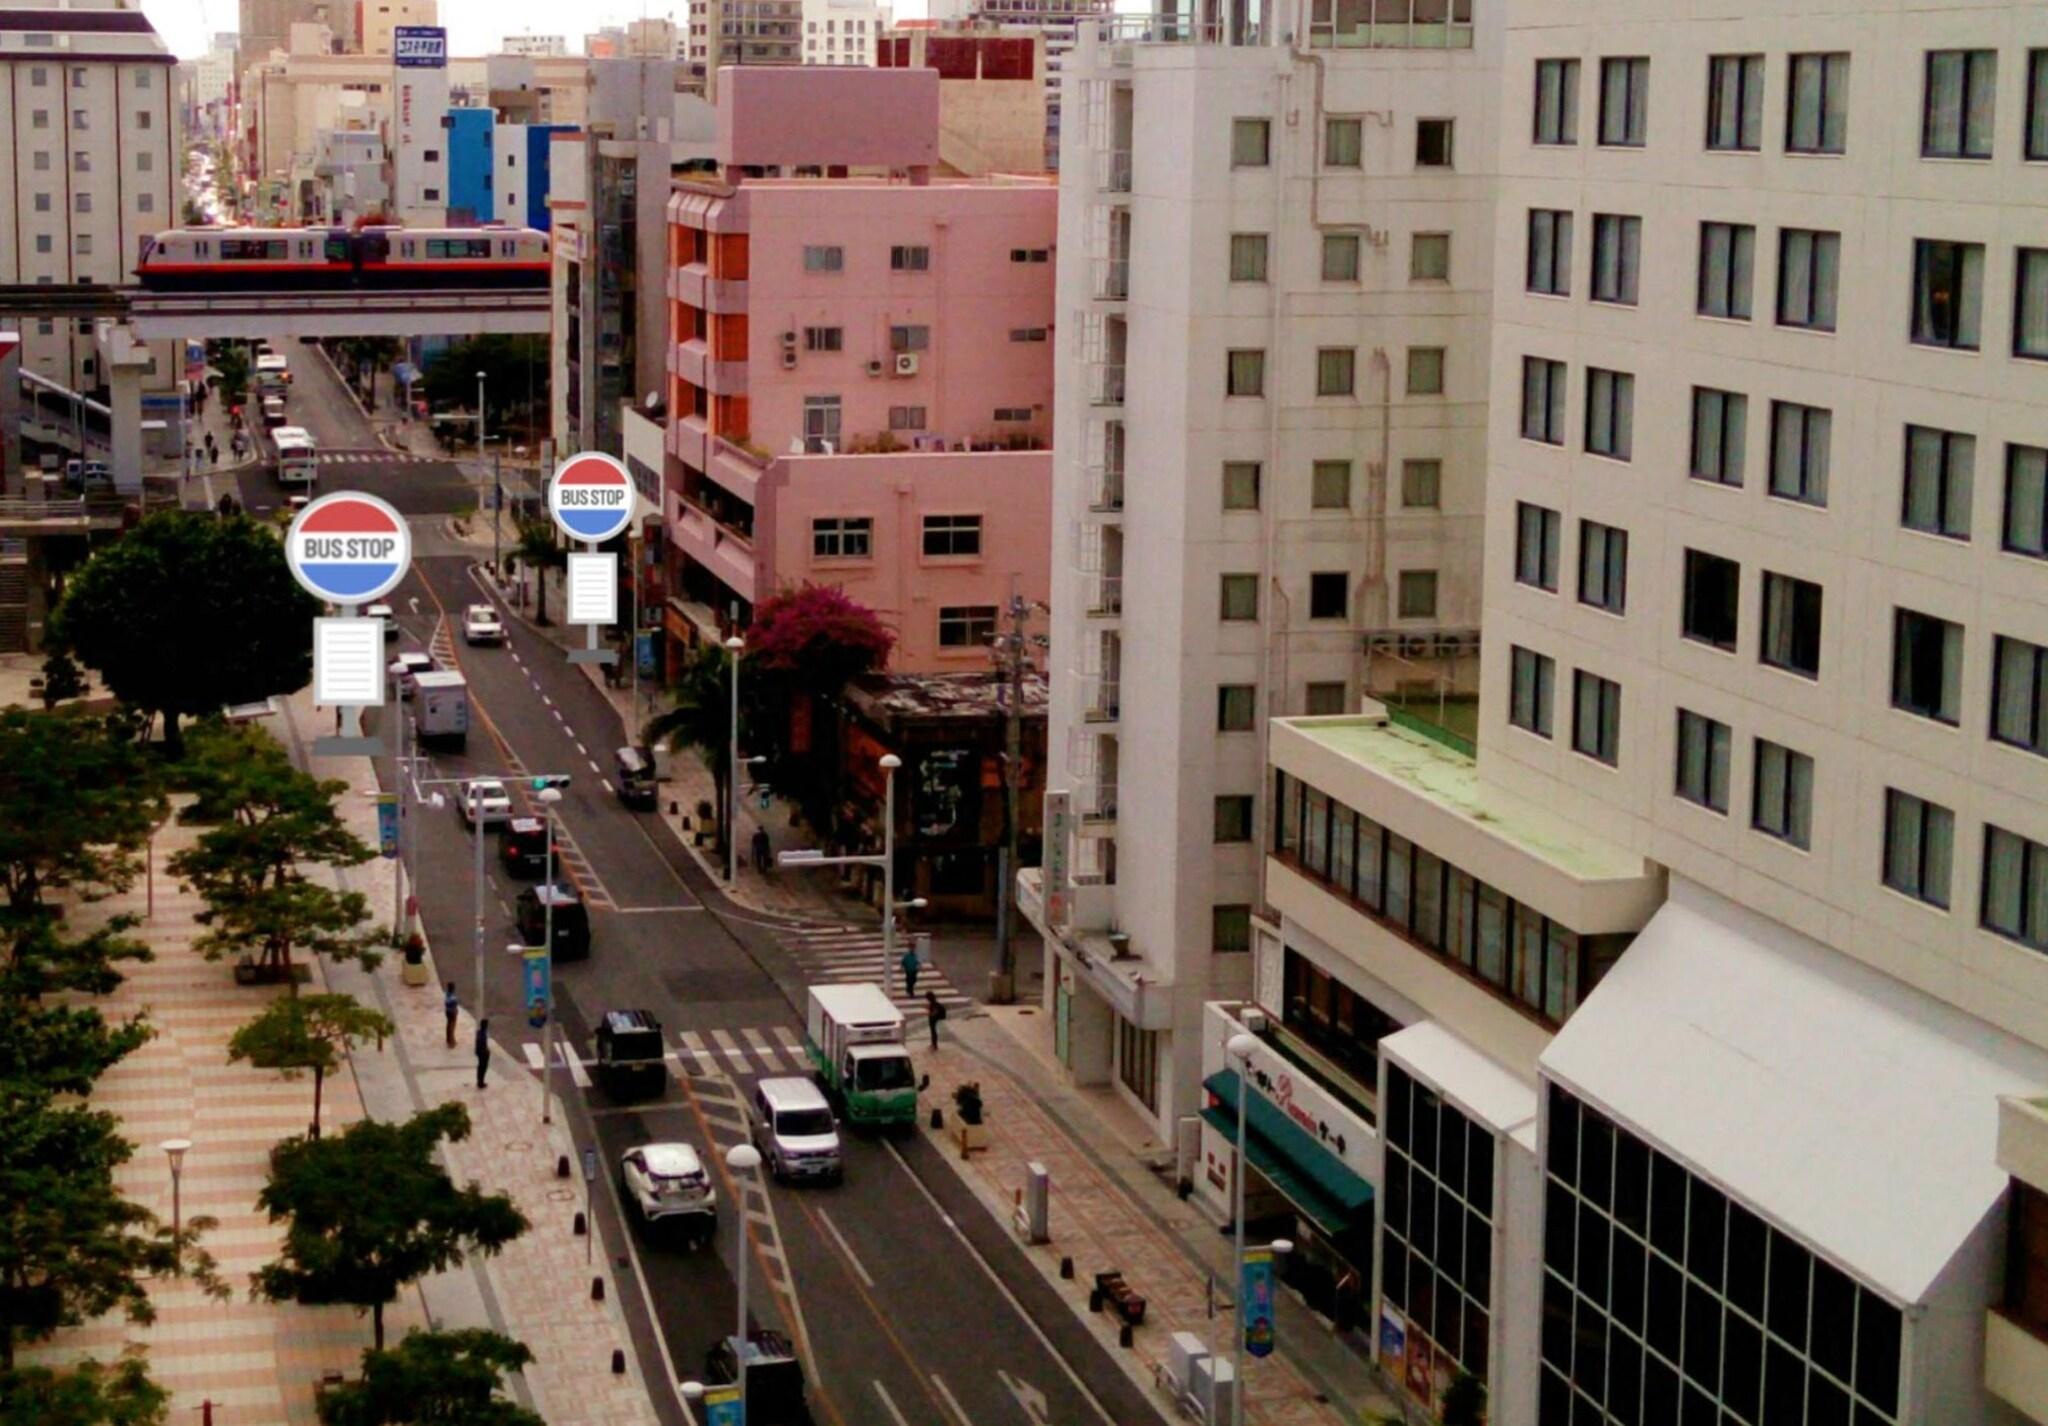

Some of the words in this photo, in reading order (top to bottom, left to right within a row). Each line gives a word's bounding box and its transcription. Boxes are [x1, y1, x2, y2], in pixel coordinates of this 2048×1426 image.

[561, 489, 589, 505] BUS
[590, 489, 624, 505] STOP
[305, 538, 343, 558] BUS
[346, 538, 395, 558] STOP
